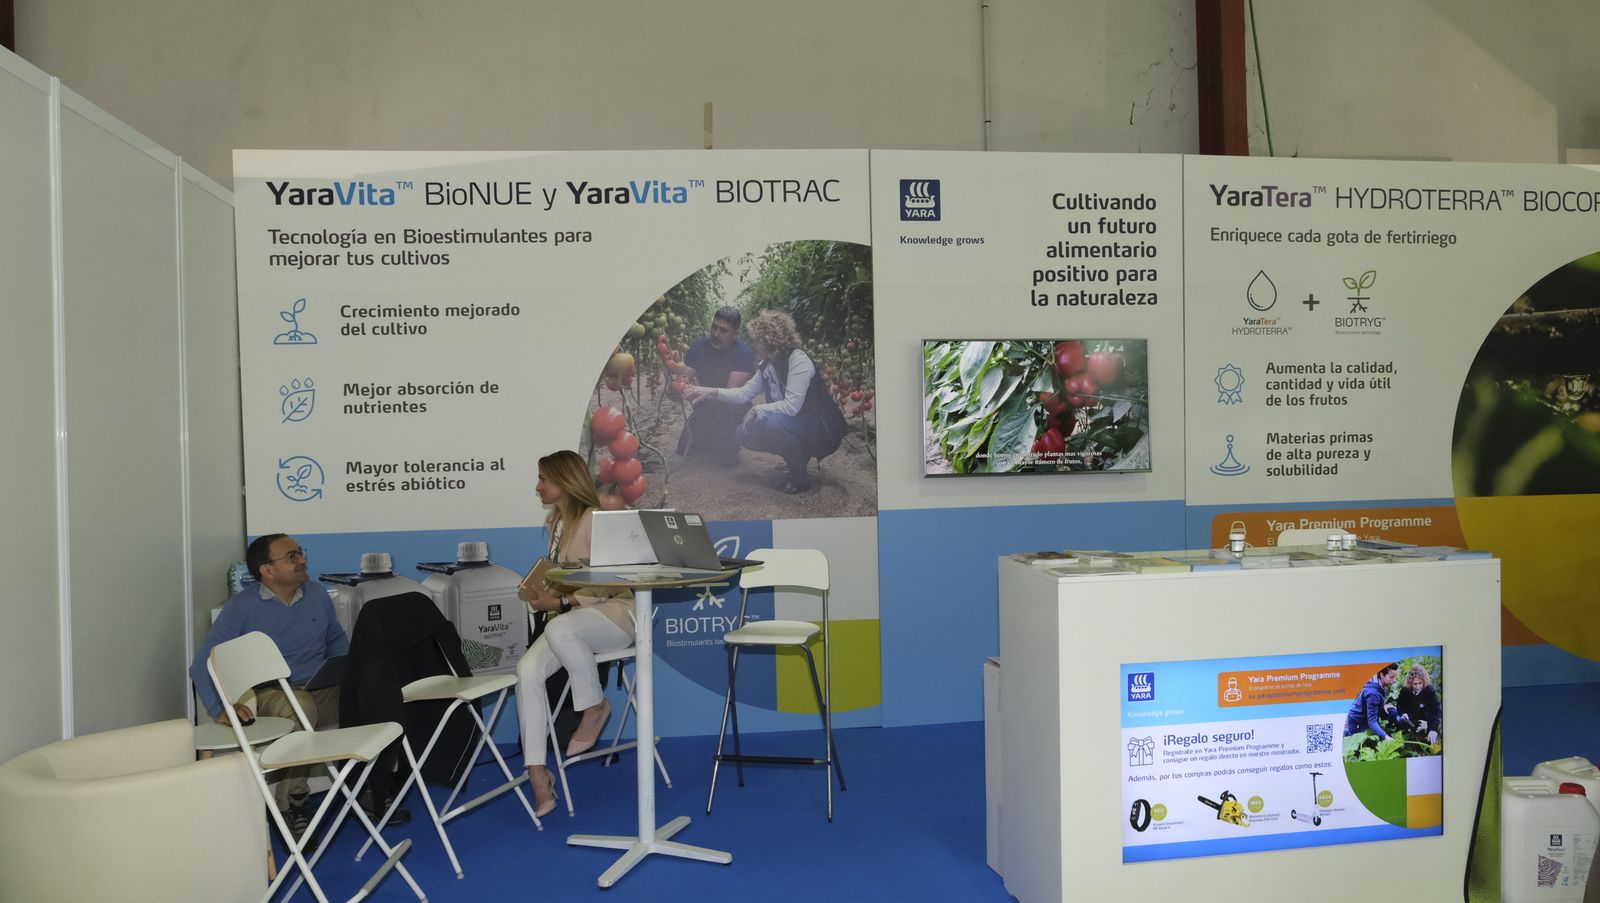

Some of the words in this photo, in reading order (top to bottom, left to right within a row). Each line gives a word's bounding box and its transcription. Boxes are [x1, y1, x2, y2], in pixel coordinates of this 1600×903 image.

[425, 181, 532, 206] BioNUE
[542, 187, 557, 211] y
[716, 179, 841, 203] BIOTRAC
[1052, 193, 1157, 210] Cultivando
[905, 209, 936, 218] YARA
[1068, 221, 1091, 234] un
[1098, 217, 1157, 234] futuro
[268, 228, 367, 248] Tecnología
[374, 232, 396, 245] en
[403, 228, 548, 245] Bioestimulantes
[554, 230, 592, 246] para
[900, 235, 953, 246] Knowledge
[956, 236, 985, 246] grows
[1210, 227, 1282, 245] Enriquece
[1287, 229, 1321, 243] cada
[1327, 231, 1359, 247] gota
[1364, 230, 1382, 244] de
[1386, 229, 1457, 248] fertirriego
[1046, 241, 1157, 258] alimentario
[269, 251, 340, 269] mejorar
[347, 252, 375, 266] tus
[381, 250, 450, 266] cultivos
[1032, 265, 1109, 286] positivo
[1116, 268, 1158, 285] para
[1031, 290, 1049, 306] la
[1056, 289, 1158, 306] naturaleza
[340, 304, 440, 319] Crecimiento
[445, 303, 520, 320] mejorado
[340, 322, 366, 337] del
[371, 321, 427, 336] cultivo
[1265, 362, 1326, 374] Aumenta
[1330, 362, 1342, 374] la
[1347, 361, 1398, 375] calidad,
[343, 382, 392, 399] Mejor
[397, 381, 474, 395] absorción
[480, 380, 499, 394] de
[1265, 378, 1322, 390] cantidad
[1326, 381, 1334, 392] y
[1338, 378, 1365, 390] vida
[1369, 377, 1391, 389] útil
[343, 401, 427, 414] nutrientes
[1266, 395, 1281, 406] de
[1286, 394, 1305, 406] los
[1309, 394, 1348, 406] frutos
[1266, 432, 1325, 444] Materias
[1330, 432, 1373, 446] primas
[1266, 449, 1282, 461] de
[1286, 448, 1312, 460] alta
[1316, 450, 1359, 462] pureza
[1363, 449, 1371, 460] y
[346, 461, 398, 477] Mayor
[403, 459, 485, 473] tolerancia
[490, 458, 505, 471] al
[1266, 463, 1338, 476] solubilidad
[346, 478, 395, 492] estrés
[401, 477, 466, 491] abiótico
[1266, 519, 1296, 531] Yara
[1300, 517, 1356, 529] Premium
[1360, 516, 1432, 531] Programme
[666, 639, 713, 647] Biostimulants
[1248, 676, 1265, 684] Yara
[1266, 673, 1298, 682] Premium
[1300, 671, 1341, 680] Programme
[1212, 729, 1255, 744] seguro!
[1246, 743, 1280, 751] Programme
[1163, 757, 1188, 765] consigue
[1199, 754, 1217, 762] regalo
[1218, 752, 1238, 760] directo
[1184, 770, 1212, 778] compras
[1213, 768, 1235, 777] podrás
[1237, 766, 1268, 774] conseguir
[1269, 764, 1293, 773] regalos
